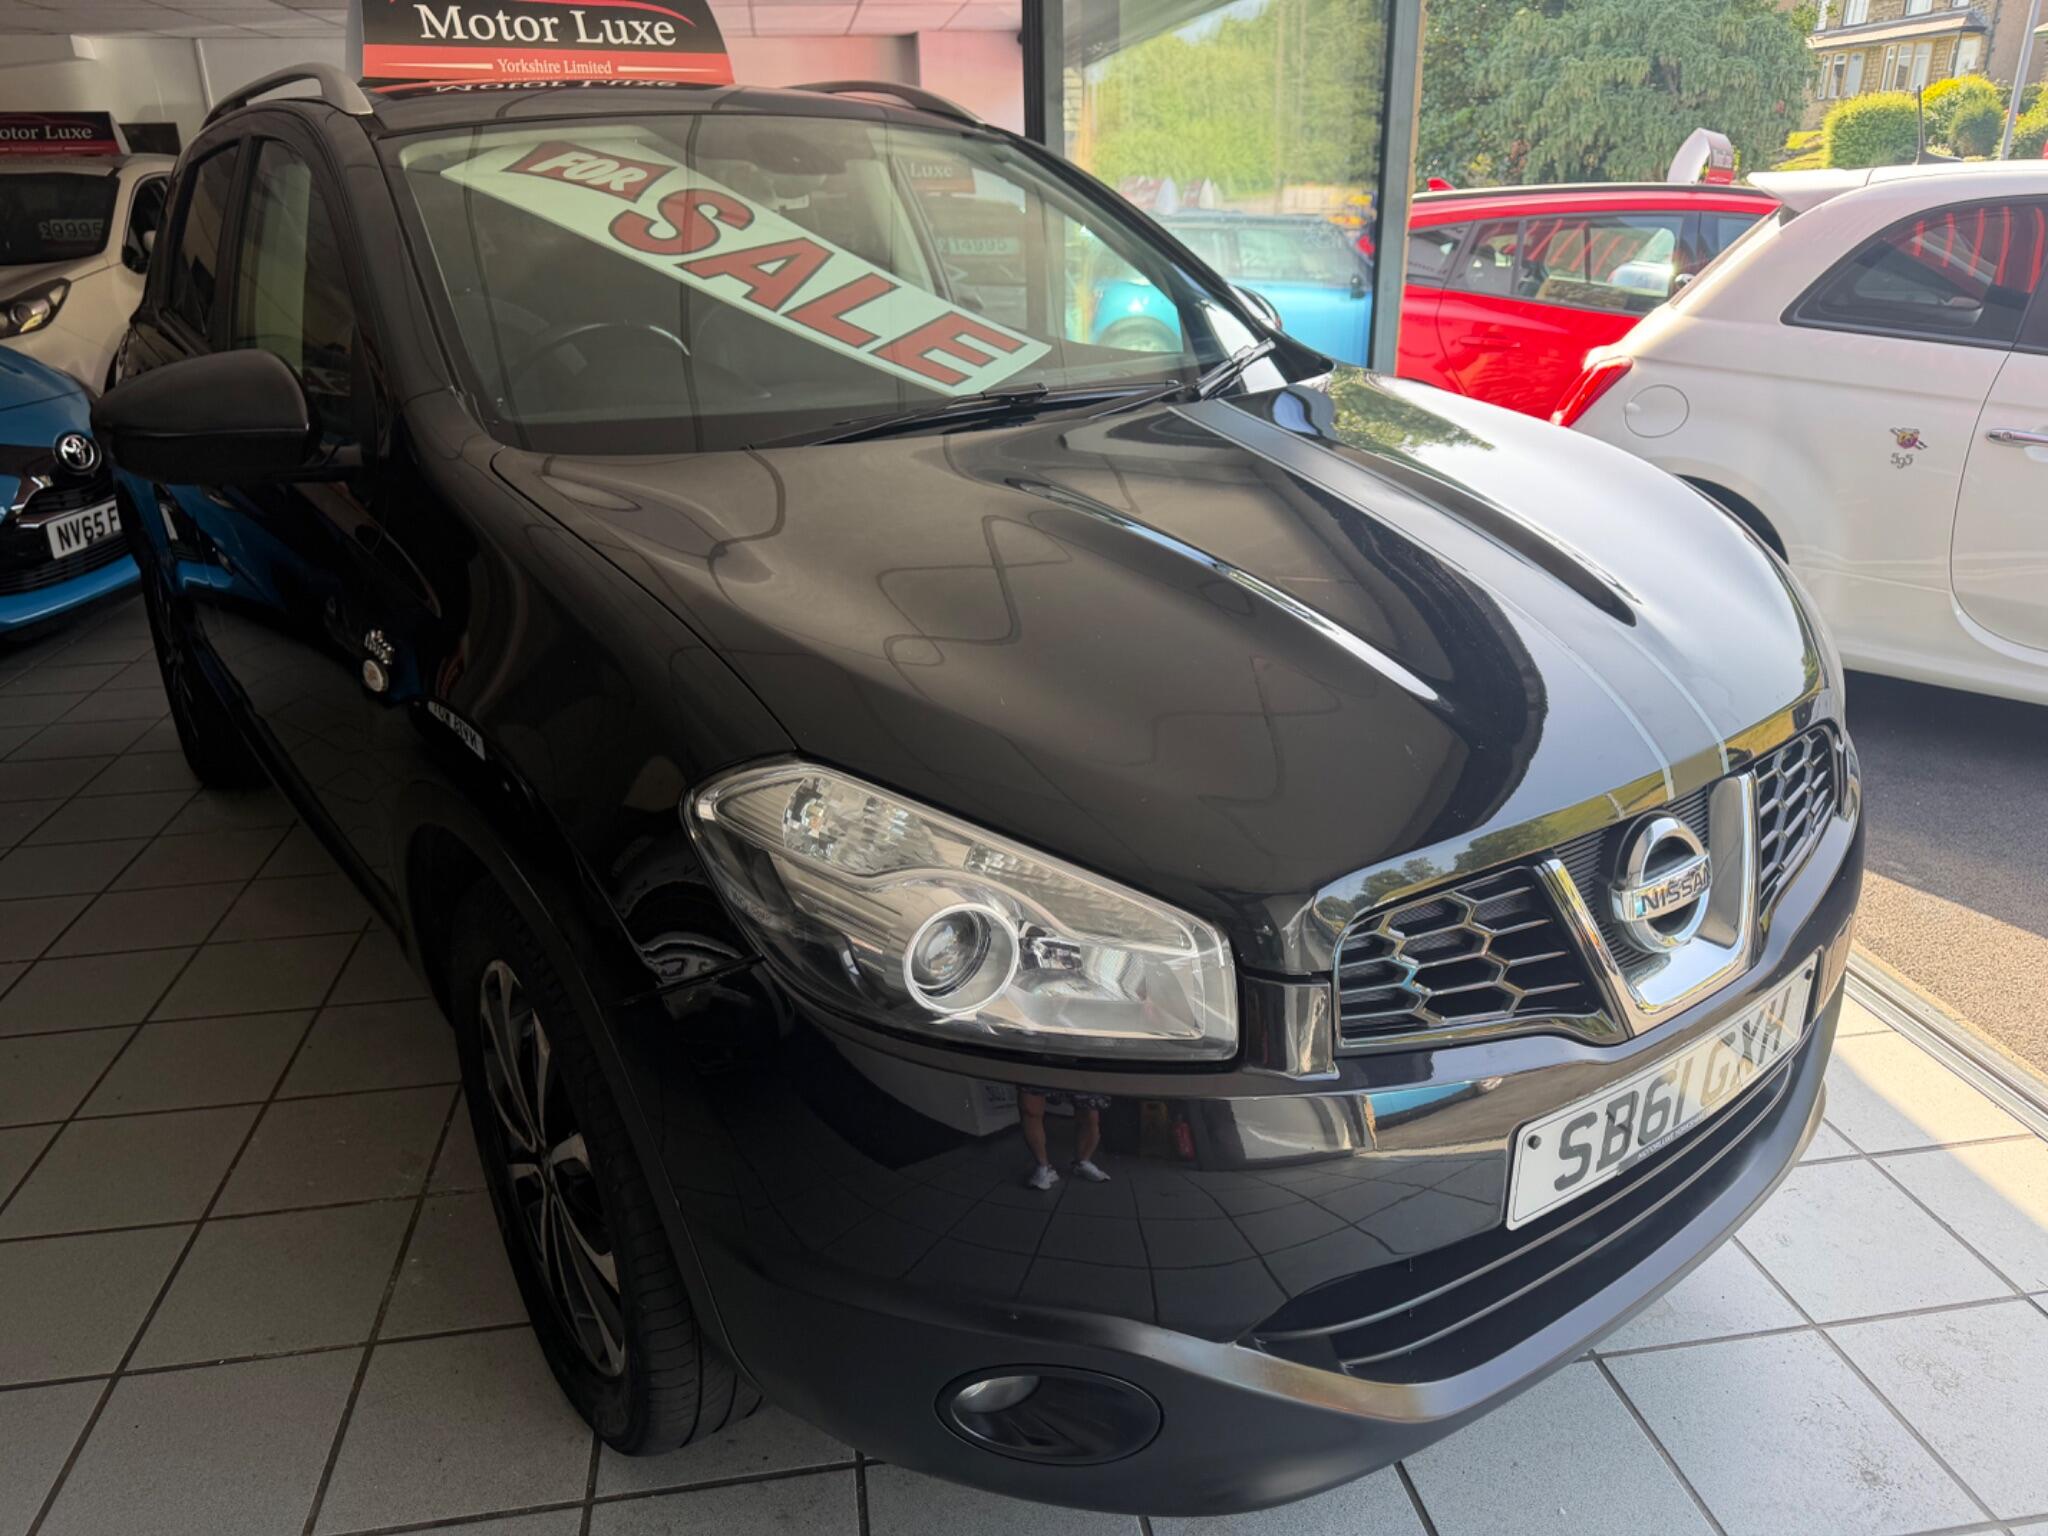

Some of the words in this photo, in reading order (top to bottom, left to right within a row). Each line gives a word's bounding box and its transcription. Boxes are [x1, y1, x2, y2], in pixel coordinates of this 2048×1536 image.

[413, 3, 559, 43] Motor
[569, 10, 677, 47] Luxe
[497, 58, 561, 74] Yorkshire
[563, 60, 613, 75] Limited
[0, 126, 38, 139] otor
[44, 124, 93, 139] Luxe
[909, 162, 952, 178] Luxe
[528, 150, 648, 193] FOR
[608, 188, 1028, 387] SALE
[1890, 452, 1914, 469] 595
[56, 512, 106, 552] NV65
[106, 505, 118, 533] F
[1553, 1057, 1694, 1192] SB61
[1700, 986, 1792, 1107] GXH
